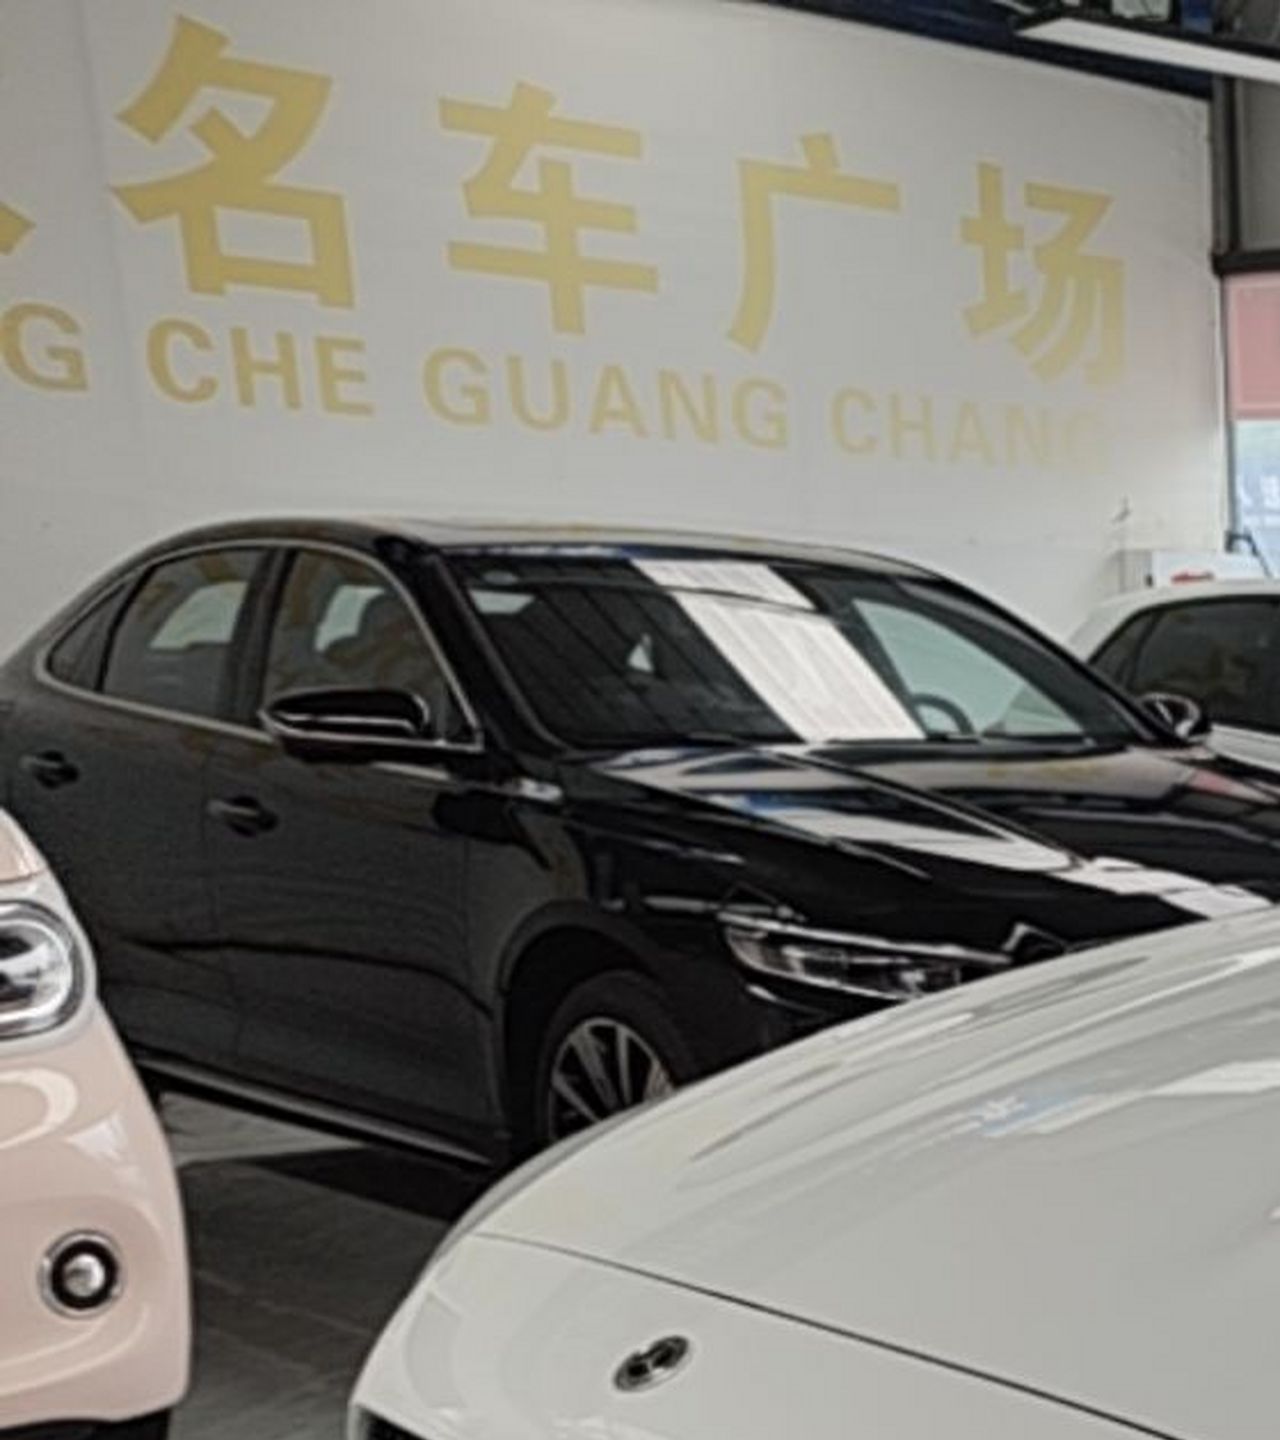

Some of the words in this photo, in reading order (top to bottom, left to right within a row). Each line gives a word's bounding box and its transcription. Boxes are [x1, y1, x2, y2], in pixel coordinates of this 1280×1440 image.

[0, 14, 1127, 386] 名车广场
[146, 318, 374, 416] CHE
[421, 345, 789, 450] GUANG
[830, 385, 1112, 474] CHANG
